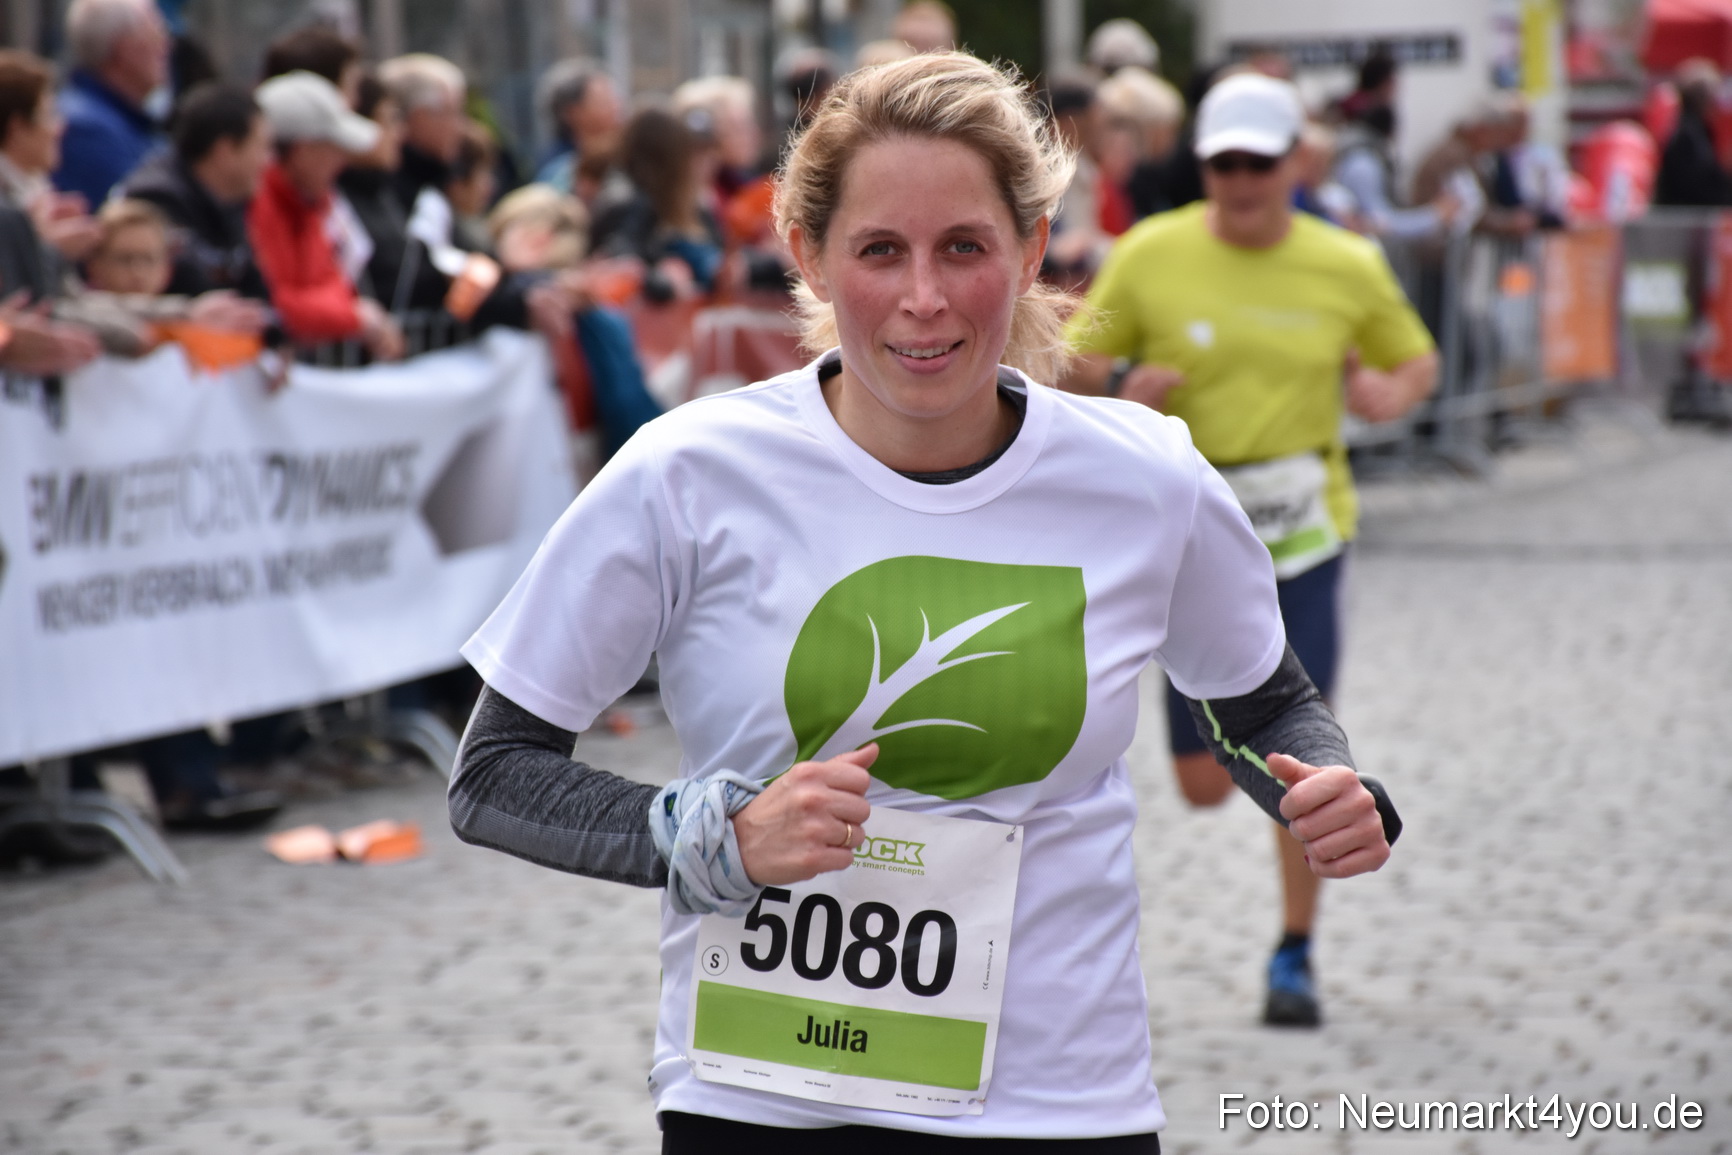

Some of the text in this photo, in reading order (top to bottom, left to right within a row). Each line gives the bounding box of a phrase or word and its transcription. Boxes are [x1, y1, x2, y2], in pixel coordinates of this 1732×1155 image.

[863, 860, 886, 871] smart
[888, 865, 925, 876] concepts
[740, 886, 957, 997] 5080
[709, 952, 721, 970] S
[797, 1015, 869, 1053] Julia
